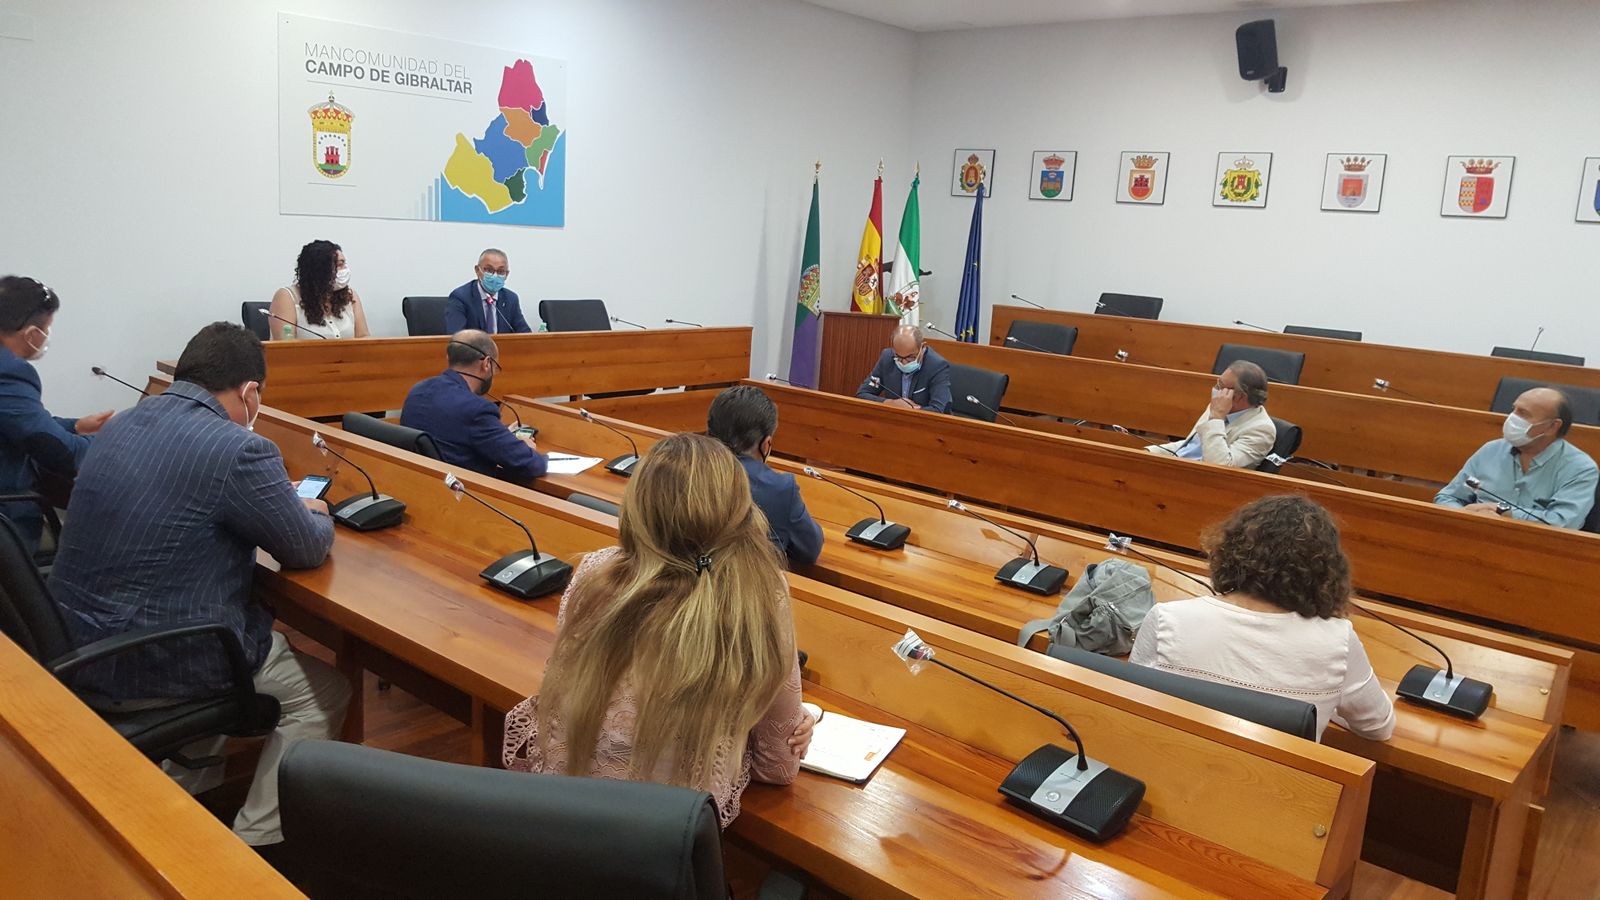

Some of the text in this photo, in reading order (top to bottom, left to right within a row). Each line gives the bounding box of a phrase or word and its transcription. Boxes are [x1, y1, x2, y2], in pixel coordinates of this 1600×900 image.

[305, 42, 471, 80] MANCOMUNIDAD DEL
[305, 59, 473, 95] CAMPO DE GIBRALTAR
